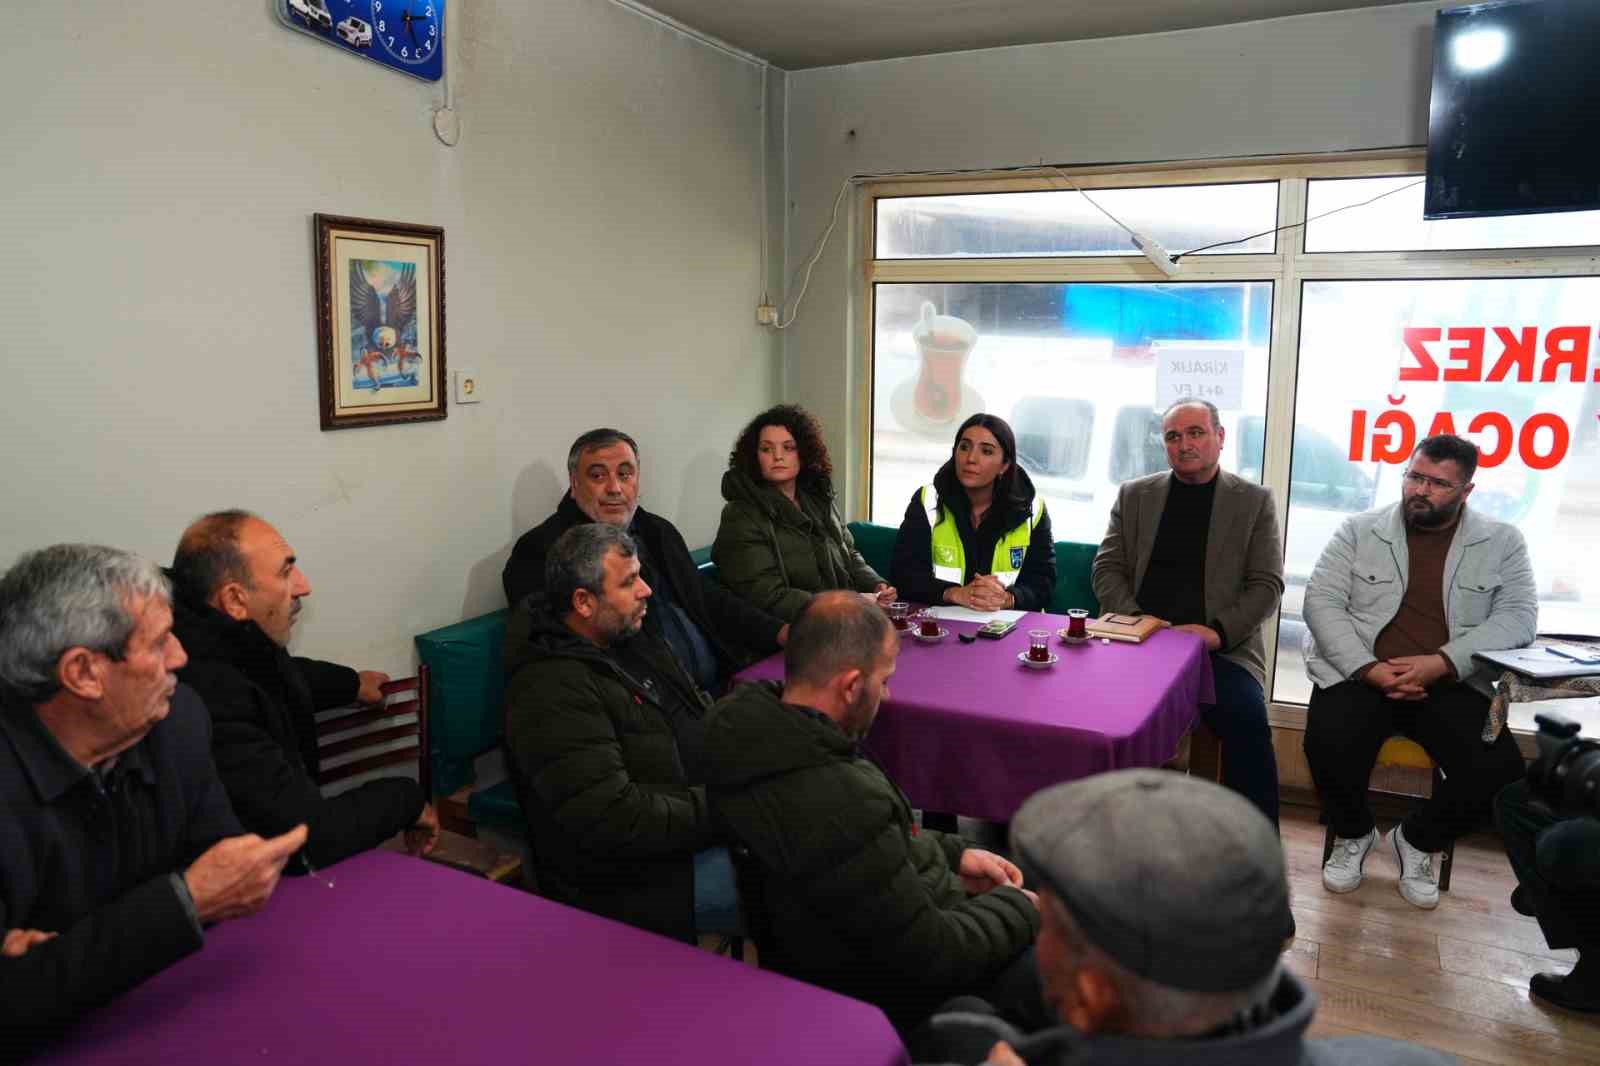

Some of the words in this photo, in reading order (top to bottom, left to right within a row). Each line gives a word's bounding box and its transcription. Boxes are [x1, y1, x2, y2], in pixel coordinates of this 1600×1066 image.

[375, 1, 382, 12] 9
[425, 5, 432, 17] 2
[378, 20, 386, 32] 8
[428, 24, 435, 36] 3
[388, 36, 395, 47] 7
[424, 39, 431, 51] 4
[400, 46, 409, 57] 6
